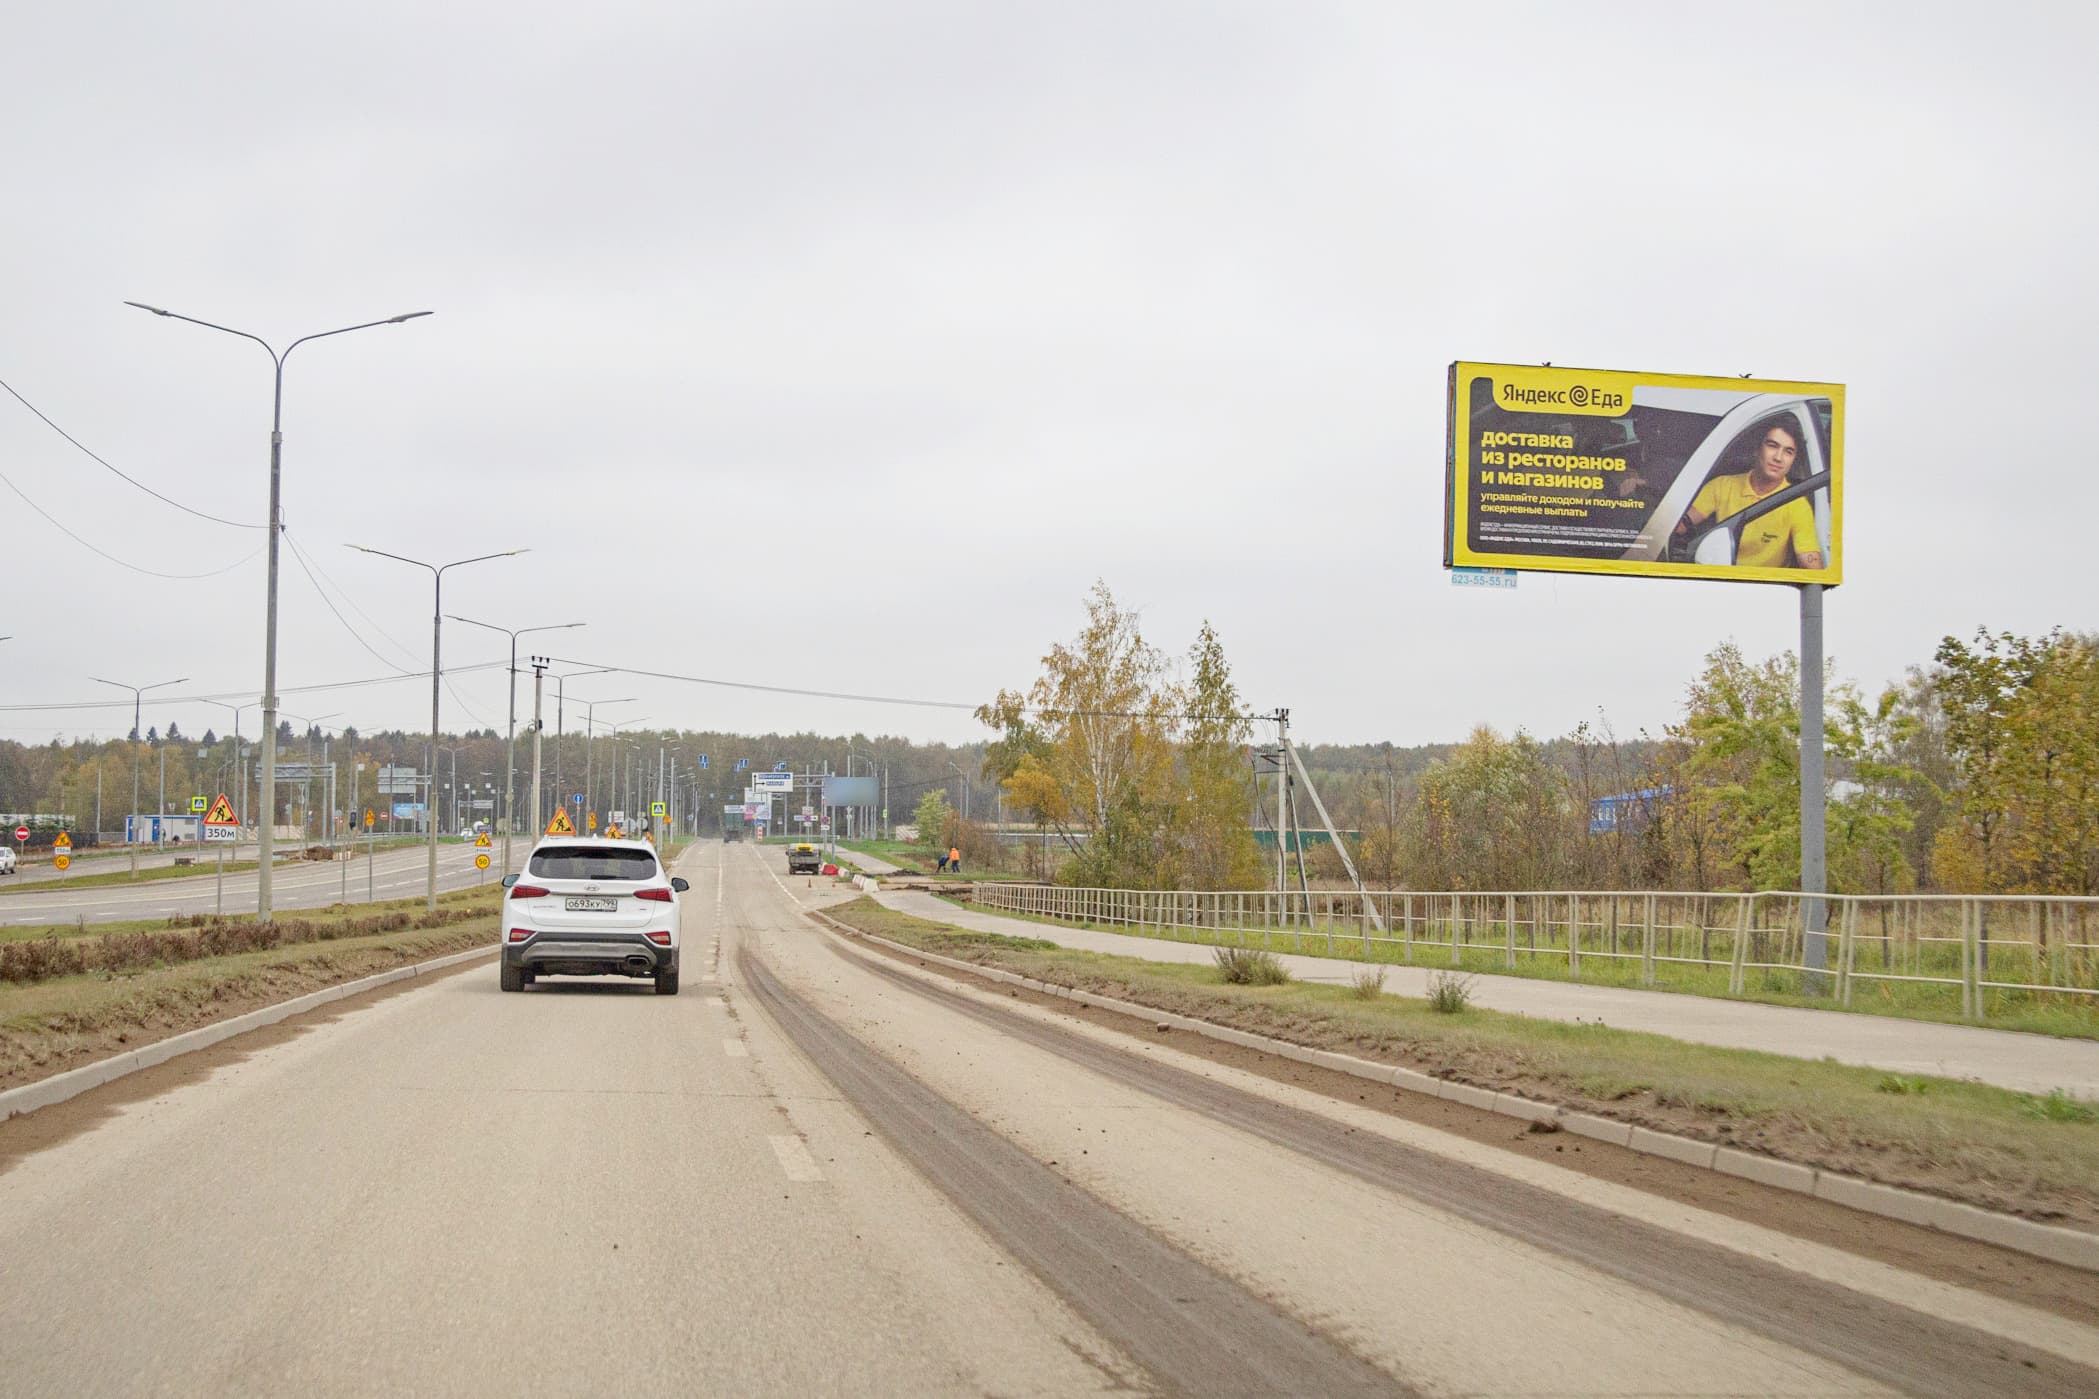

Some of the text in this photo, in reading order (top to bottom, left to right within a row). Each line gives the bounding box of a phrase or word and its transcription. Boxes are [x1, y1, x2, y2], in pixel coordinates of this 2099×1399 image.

[1503, 384, 1623, 408] Яндекс Еда
[1481, 431, 1574, 448] доставка
[1481, 451, 1627, 472] из ресторанов
[1481, 471, 1604, 490] и магазинов
[1480, 492, 1538, 505] управляйте
[1539, 496, 1583, 506] доходом
[1593, 498, 1645, 511] получайте
[1480, 504, 1588, 517] ежедневные выплаты
[207, 828, 235, 838] 350м
